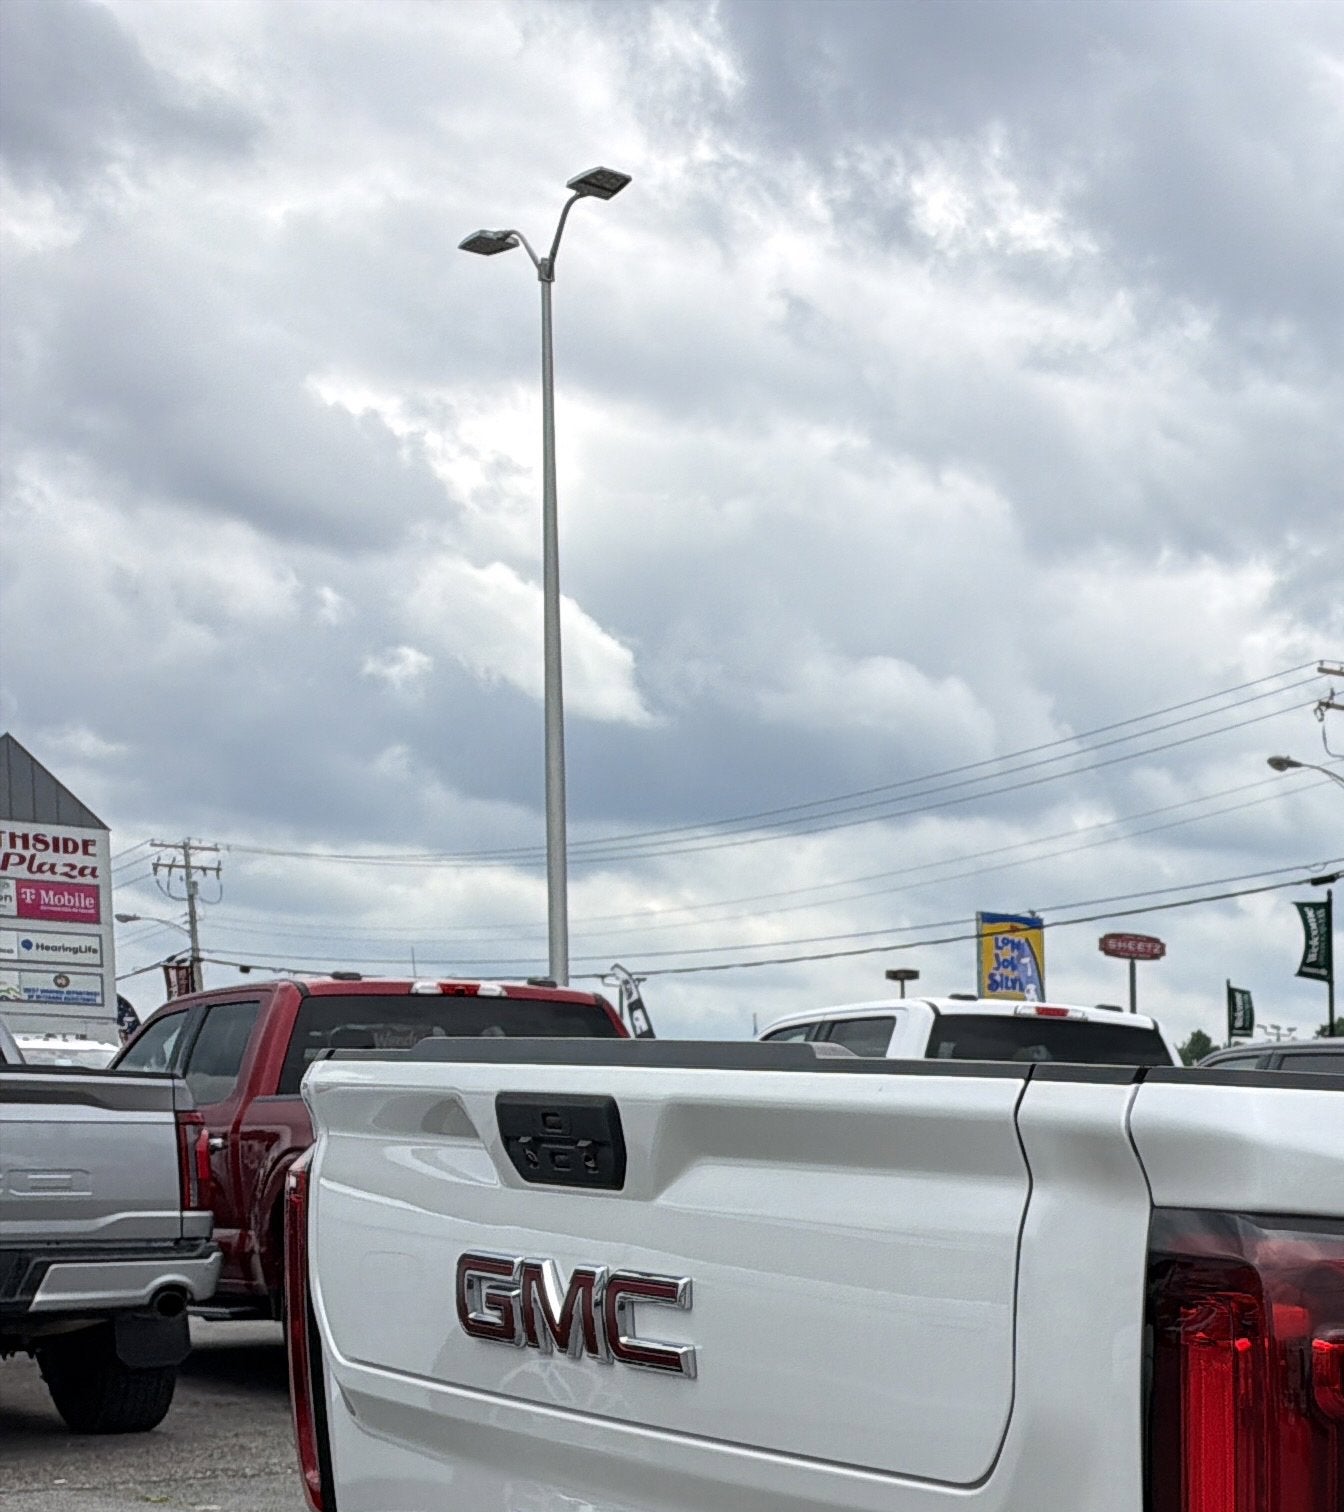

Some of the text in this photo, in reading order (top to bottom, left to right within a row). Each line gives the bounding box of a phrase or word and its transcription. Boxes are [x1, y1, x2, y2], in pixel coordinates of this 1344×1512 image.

[0, 852, 99, 879] Plaza
[40, 889, 95, 909] Mobile
[36, 942, 98, 955] HearingLife
[457, 1250, 697, 1378] GMC
